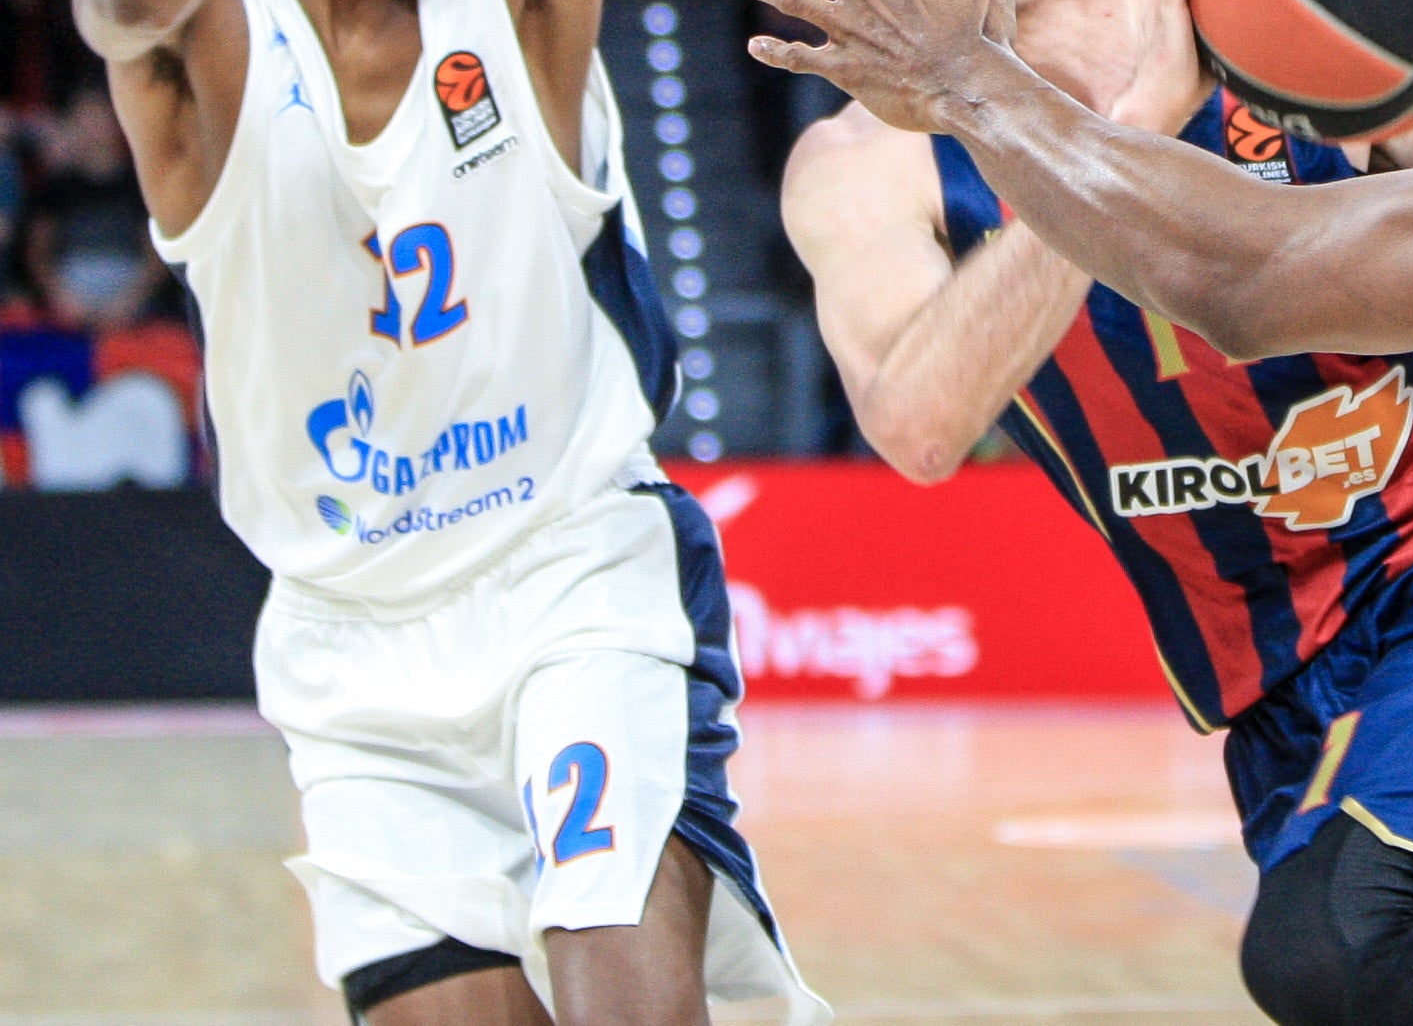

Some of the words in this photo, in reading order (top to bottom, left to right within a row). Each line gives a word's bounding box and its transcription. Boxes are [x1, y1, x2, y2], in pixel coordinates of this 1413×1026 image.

[1240, 161, 1287, 175] URKISH
[363, 221, 469, 347] 12
[516, 475, 535, 502] 2
